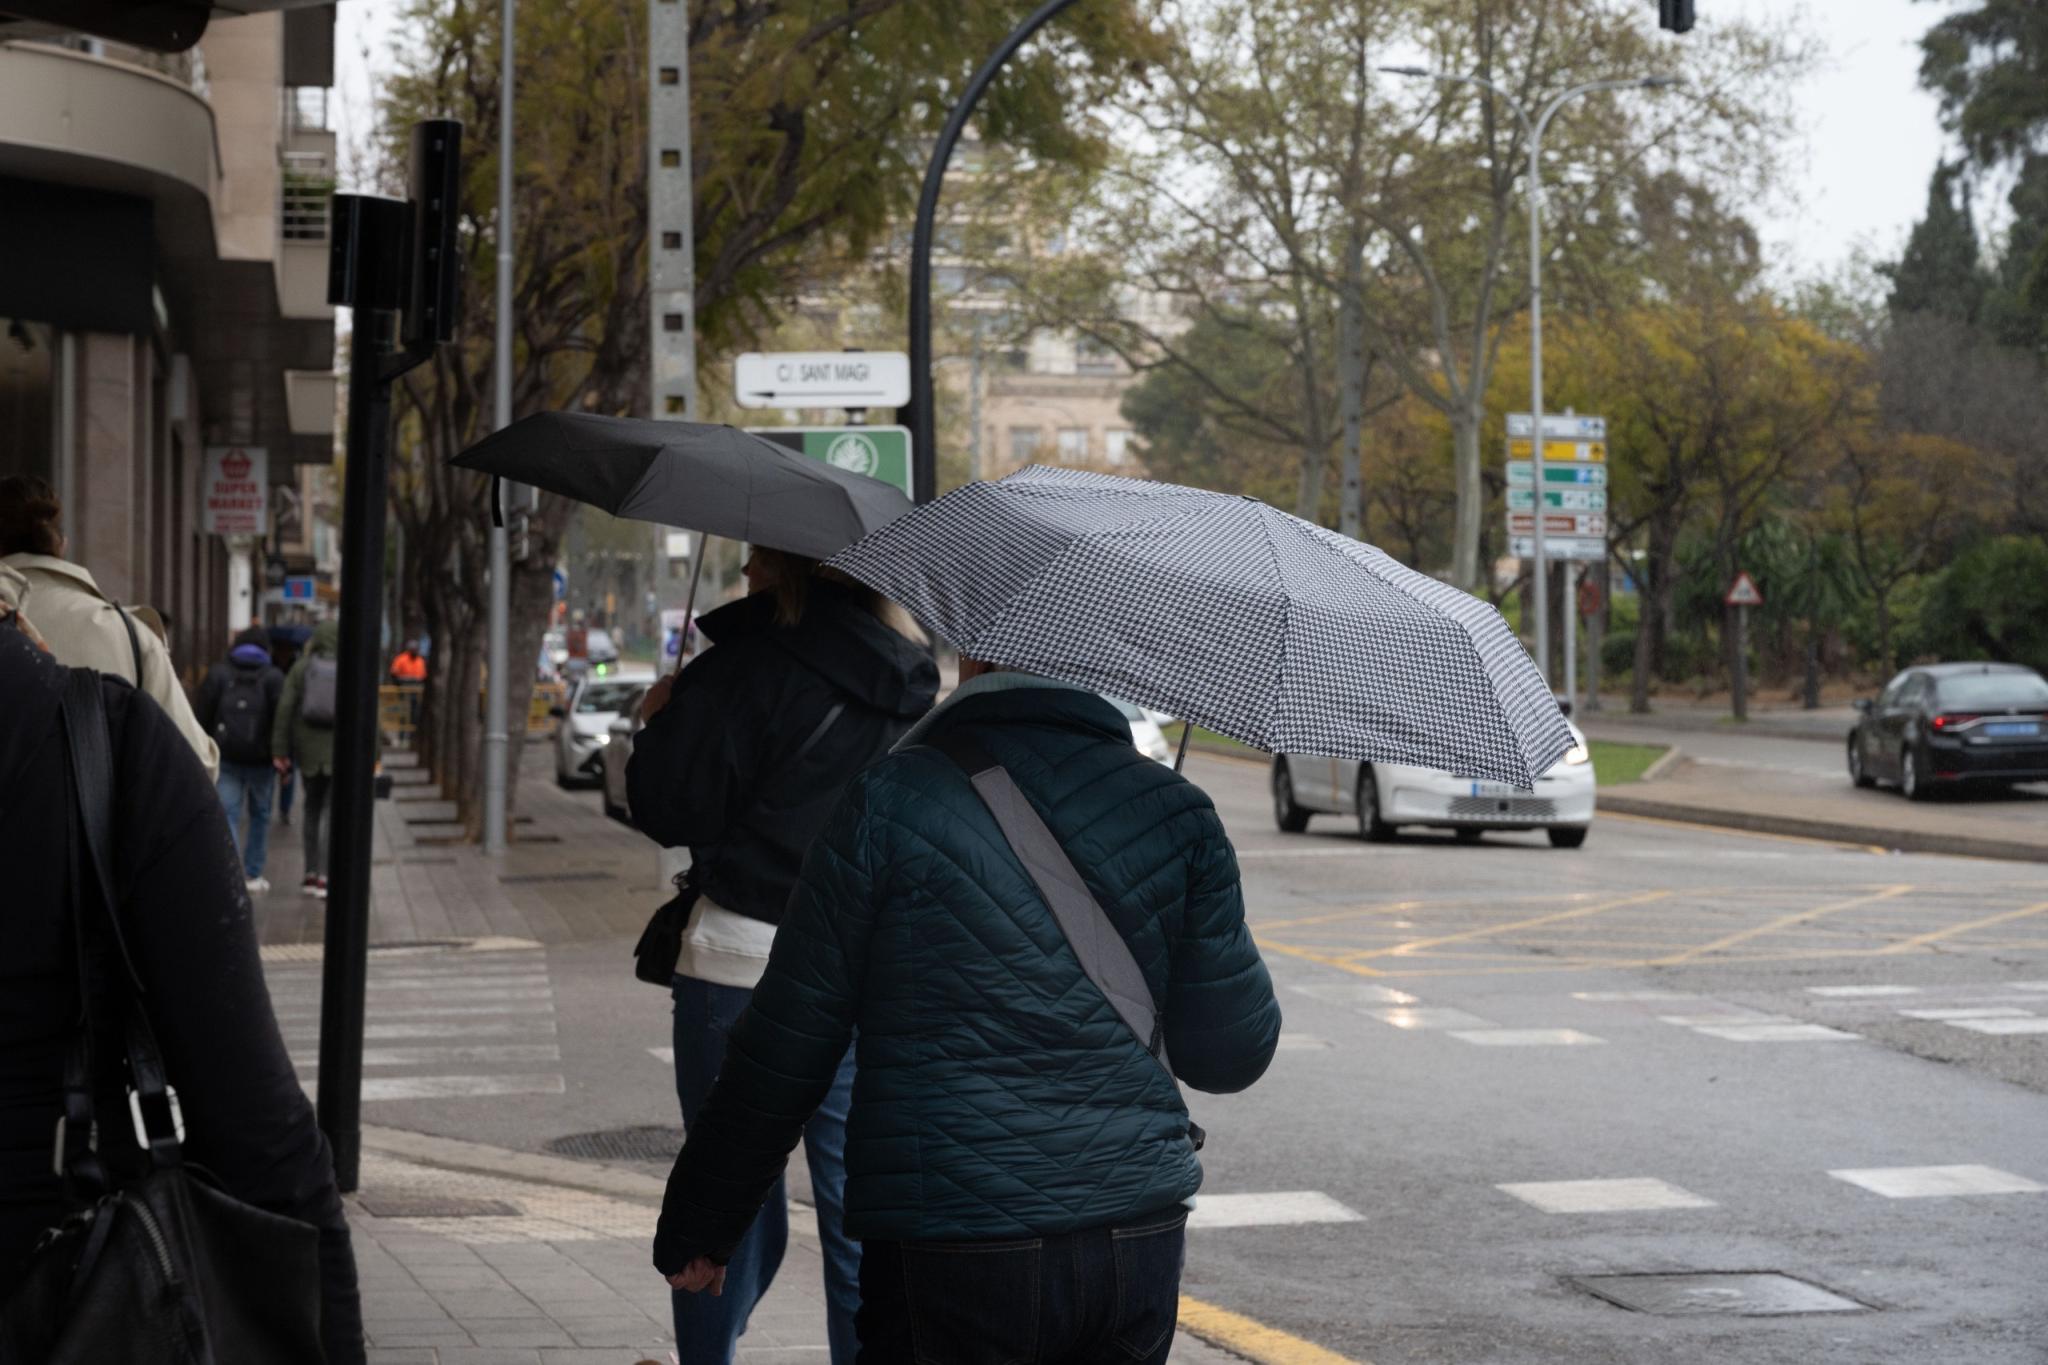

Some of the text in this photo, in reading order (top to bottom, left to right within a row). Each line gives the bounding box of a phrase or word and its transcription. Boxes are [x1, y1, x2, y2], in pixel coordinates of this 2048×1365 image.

[801, 364, 831, 382] SANT
[214, 481, 256, 494] SUPER
[208, 497, 263, 510] MARKET
